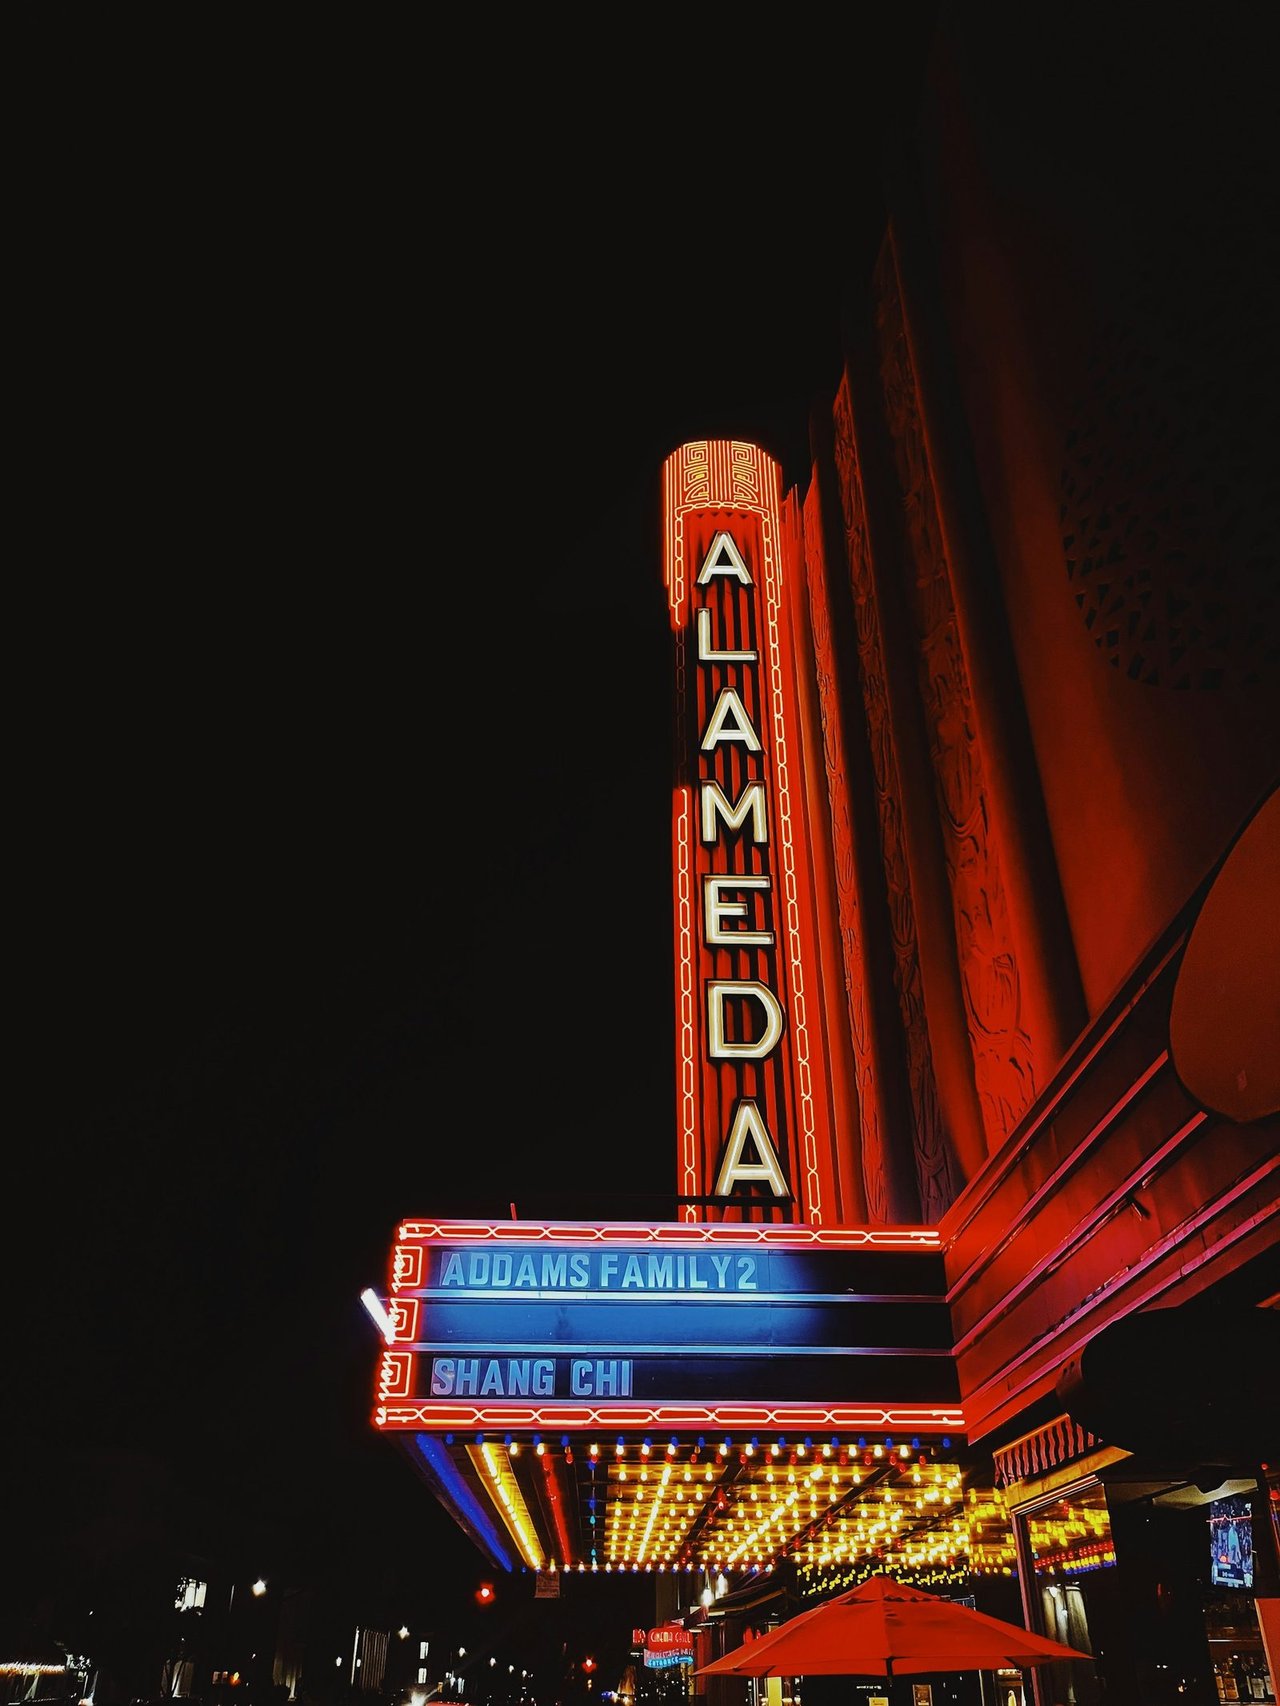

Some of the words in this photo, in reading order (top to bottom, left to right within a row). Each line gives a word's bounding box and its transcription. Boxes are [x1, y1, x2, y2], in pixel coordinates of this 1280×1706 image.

[697, 531, 790, 1197] ALAMEDA
[441, 1252, 590, 1288] ADDAMS
[431, 1359, 555, 1397] SHANG
[571, 1360, 634, 1397] CHI
